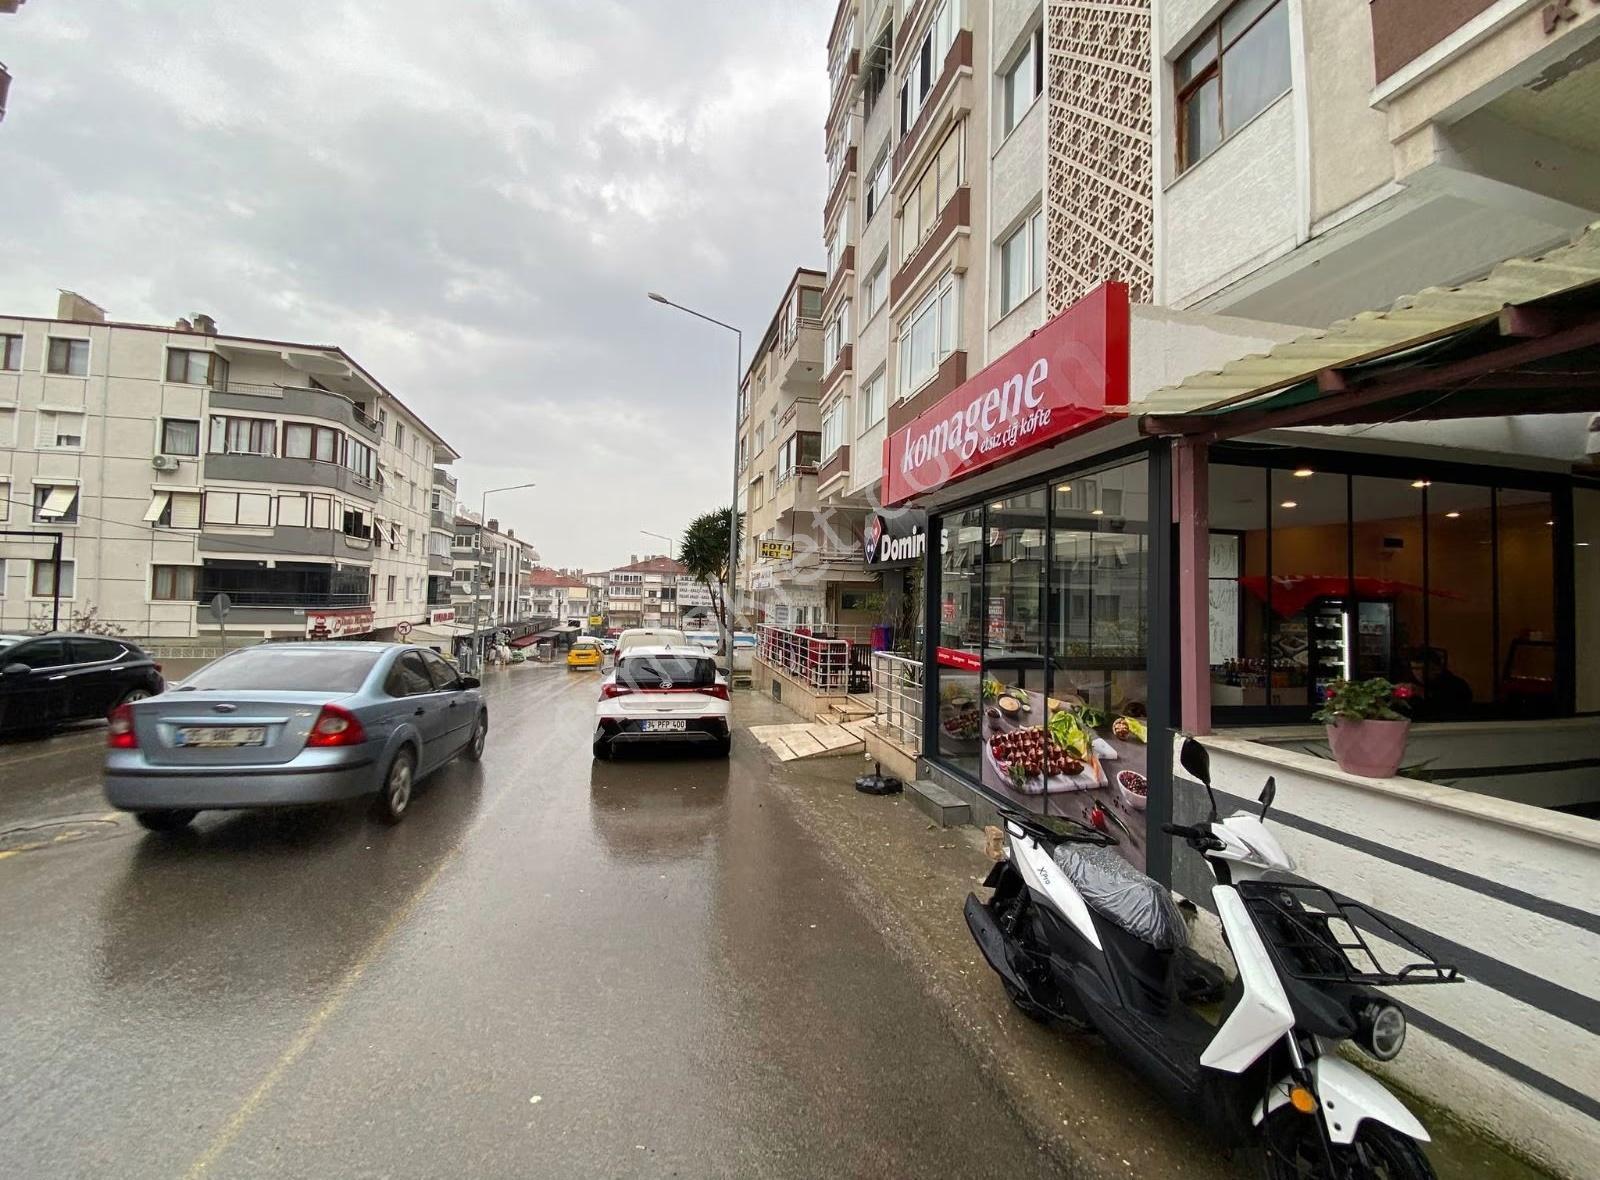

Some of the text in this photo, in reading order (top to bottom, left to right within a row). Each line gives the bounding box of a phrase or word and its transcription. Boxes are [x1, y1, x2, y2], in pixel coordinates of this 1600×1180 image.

[902, 357, 1049, 473] komagene
[979, 408, 1052, 453] etsiz çiğ köfte
[762, 542, 791, 551] FOTO
[647, 720, 685, 729] 34 PFP 400
